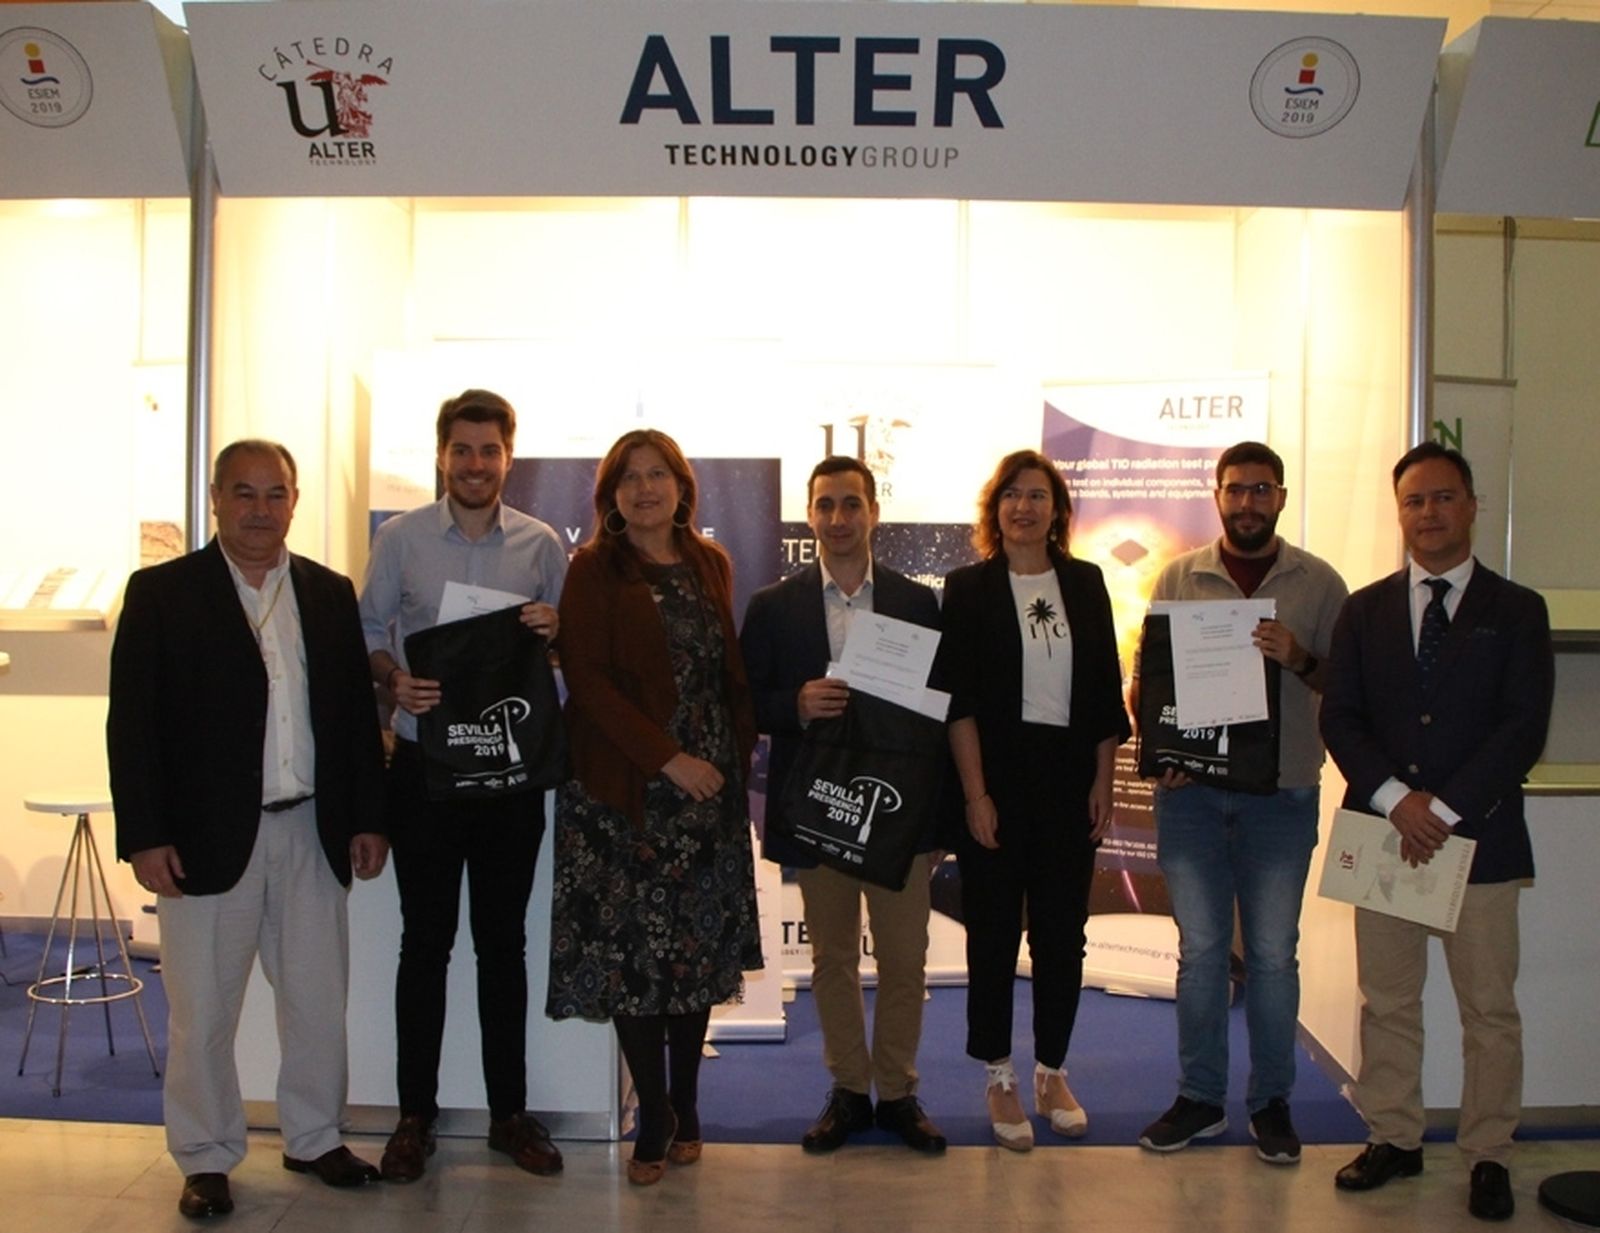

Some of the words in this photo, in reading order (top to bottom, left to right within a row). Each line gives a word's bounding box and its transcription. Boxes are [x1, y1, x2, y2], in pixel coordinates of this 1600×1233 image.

[258, 37, 394, 81] CÁTEDRA
[619, 35, 1006, 128] ALTER
[28, 88, 61, 99] ESIEM
[30, 102, 62, 113] 2019
[1284, 98, 1319, 110] ESIEM
[1281, 111, 1314, 123] 2019
[309, 142, 376, 158] ALTER
[1159, 395, 1244, 419] ALTER
[448, 723, 502, 737] SEVILLA
[1182, 727, 1216, 740] 2019
[474, 743, 505, 756] 2019
[812, 778, 864, 807] SEVILLA
[807, 789, 862, 815] PRESIDENCIA
[827, 806, 860, 827] 2019
[781, 921, 810, 944] TE
